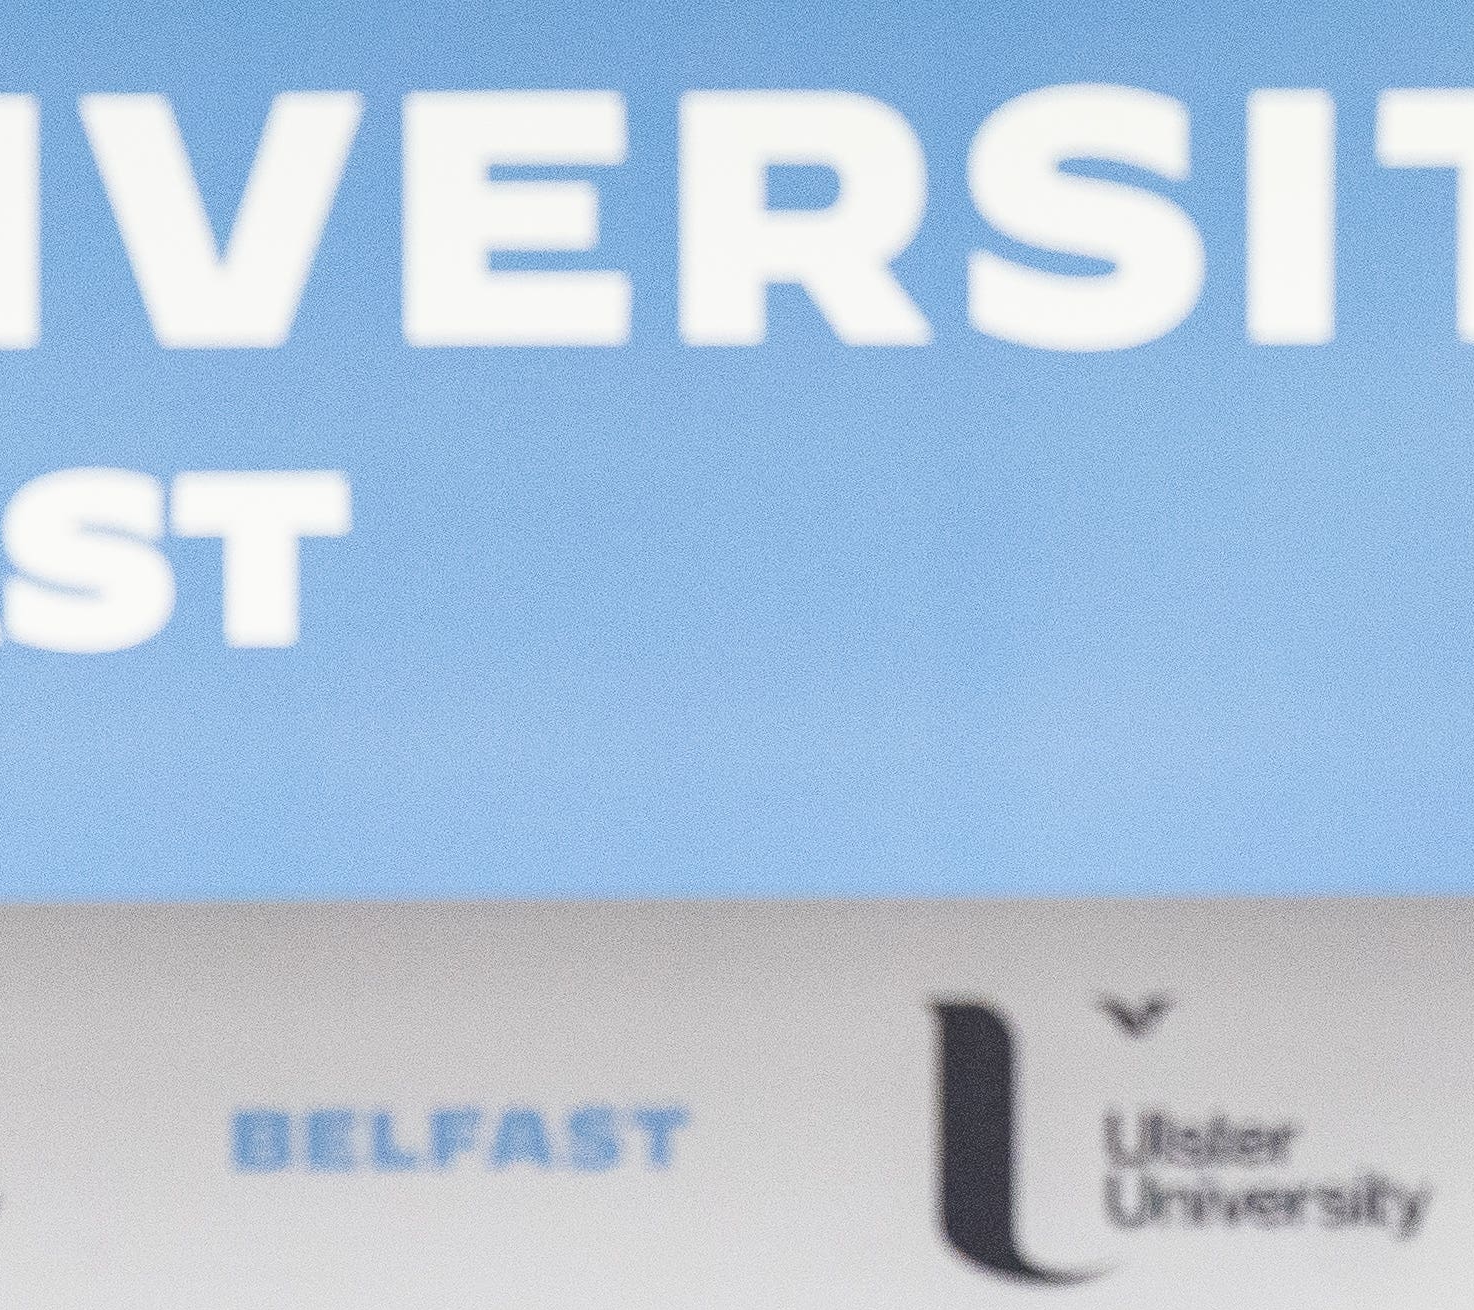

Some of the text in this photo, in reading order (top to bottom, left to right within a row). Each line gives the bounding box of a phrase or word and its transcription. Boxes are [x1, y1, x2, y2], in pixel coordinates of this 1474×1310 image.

[228, 1103, 689, 1174] BELFAST
[1106, 1110, 1295, 1165] Ulster
[1106, 1174, 1427, 1236] University
